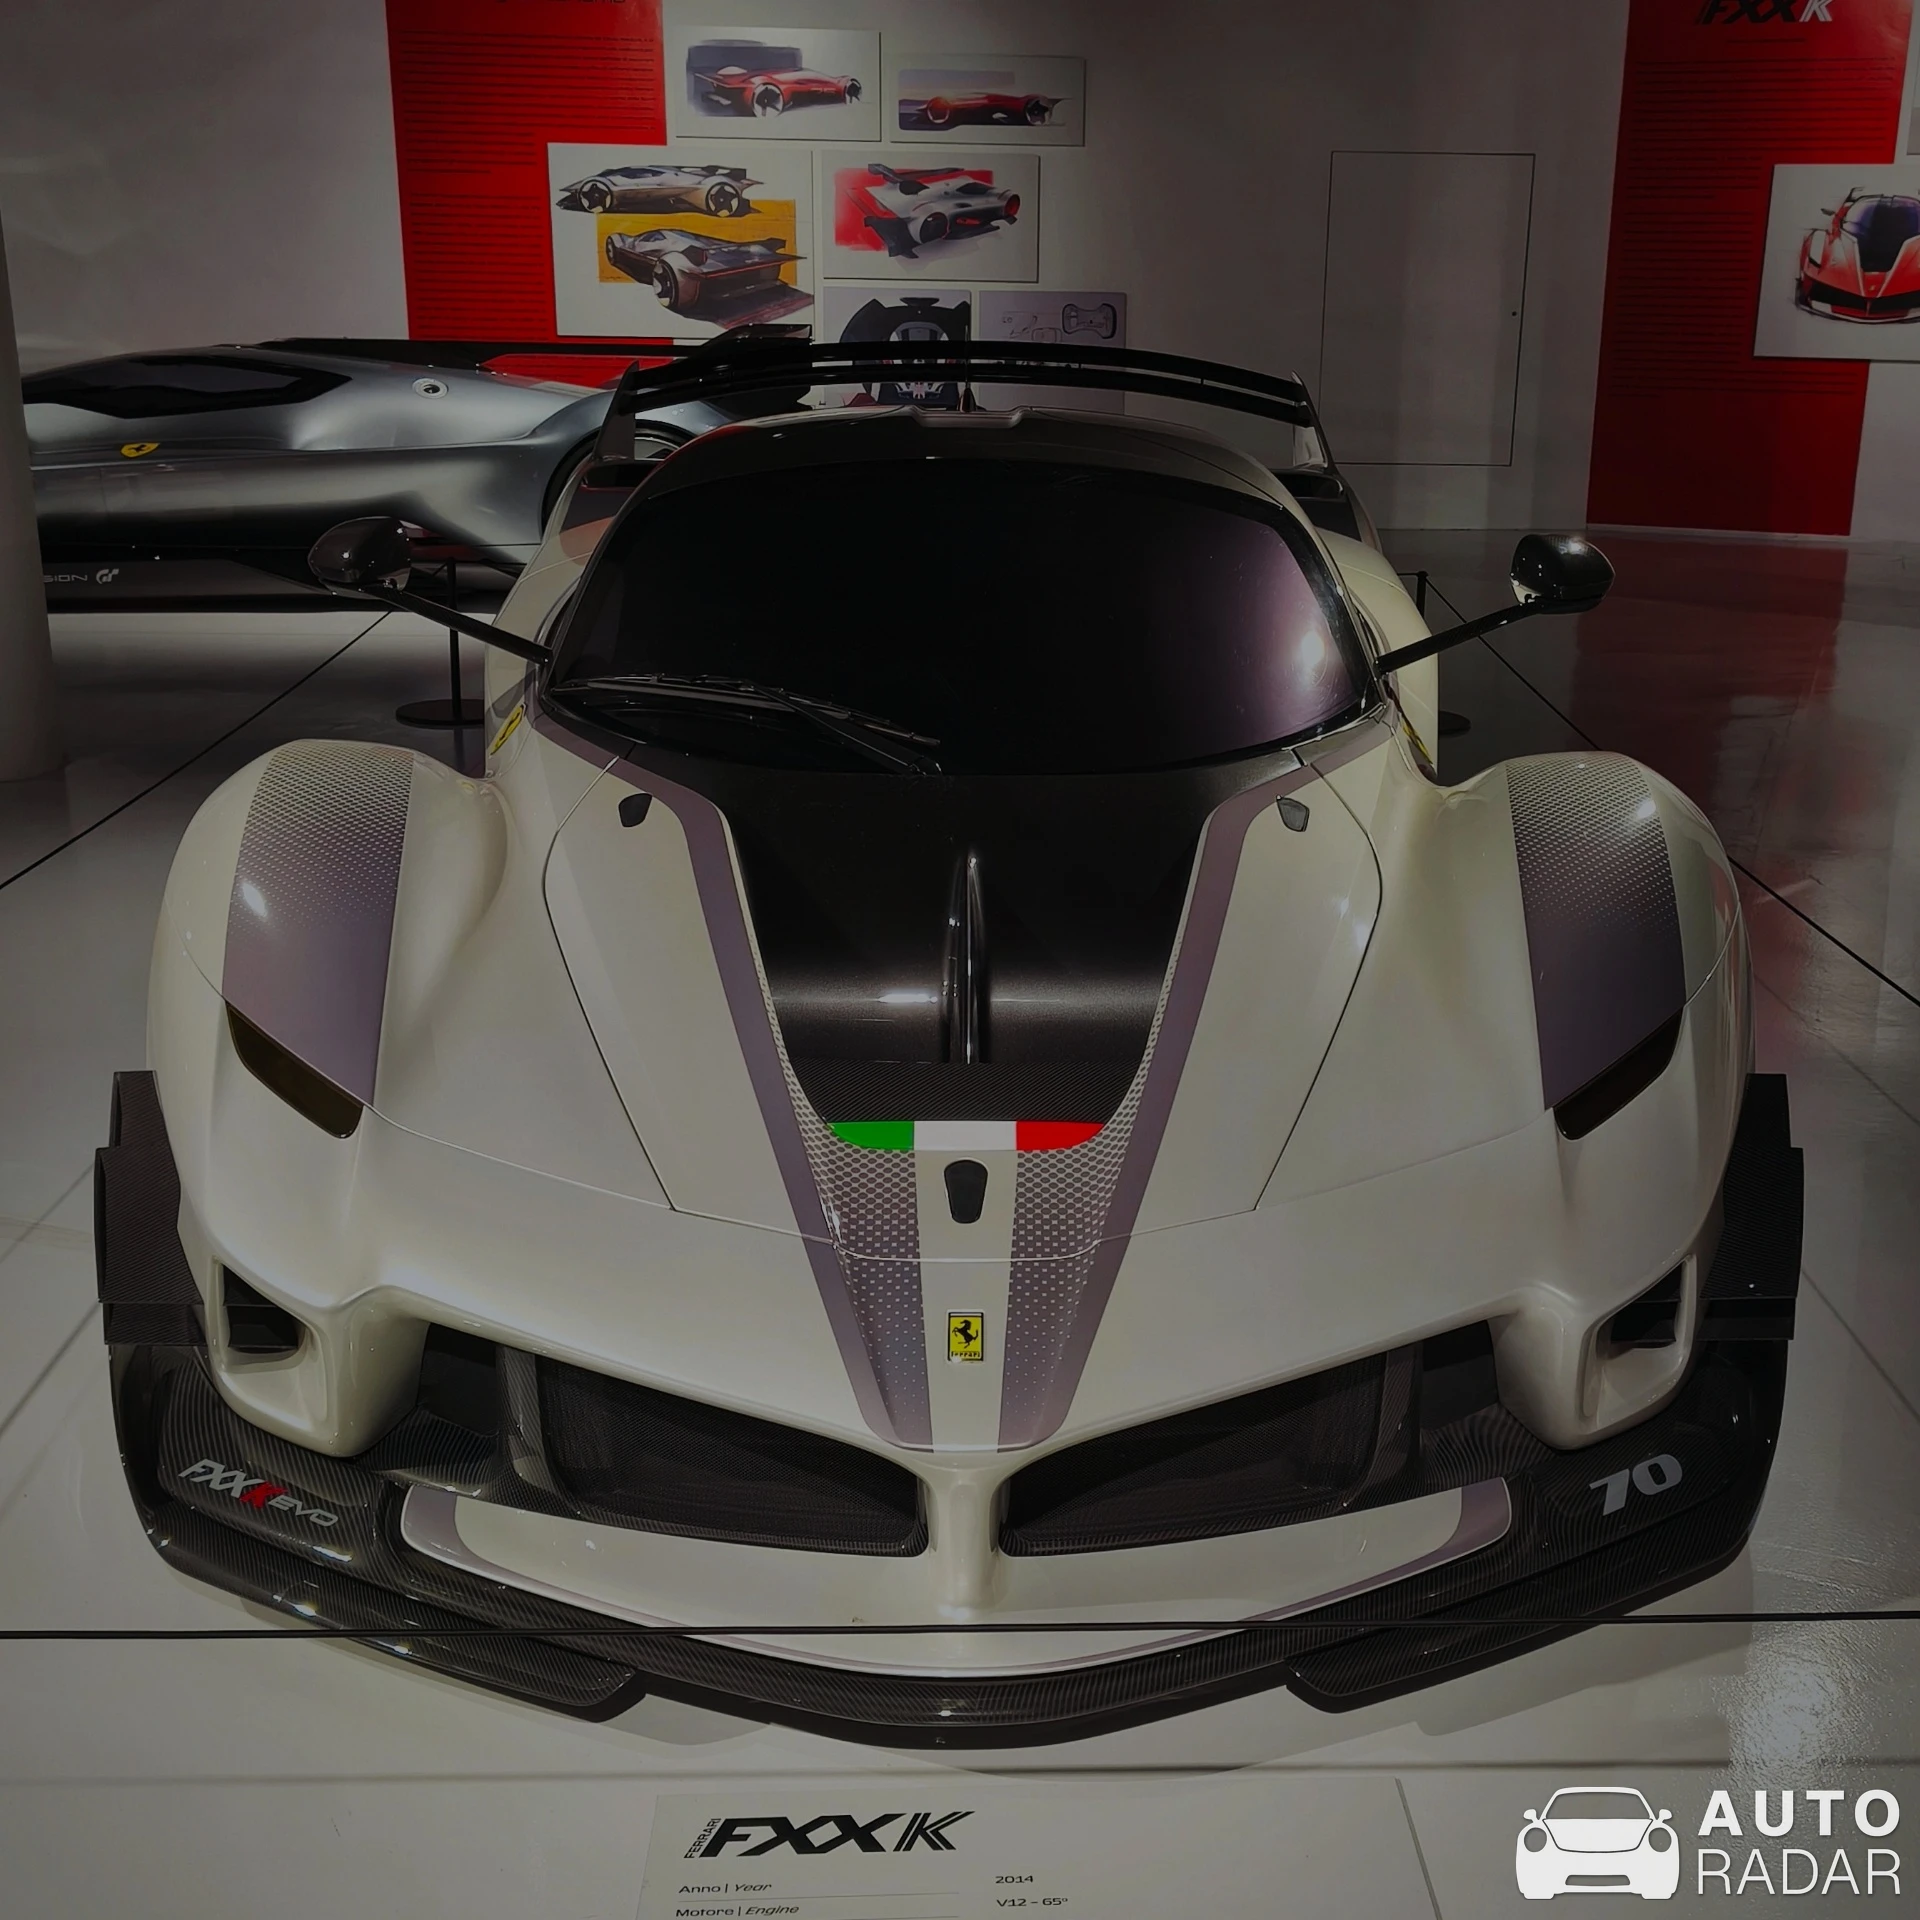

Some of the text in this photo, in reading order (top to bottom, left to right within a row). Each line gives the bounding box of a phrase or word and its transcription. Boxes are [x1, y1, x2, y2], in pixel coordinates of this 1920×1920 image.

[1589, 1453, 1683, 1517] 70
[268, 1494, 339, 1527] EVO
[684, 1818, 722, 1858] FERRARI
[995, 1875, 1034, 1884] 2014
[679, 1885, 721, 1893] Anno
[735, 1883, 772, 1892] Year
[996, 1898, 1027, 1907] V12
[676, 1909, 734, 1917] Motore
[745, 1905, 800, 1916] Engine
